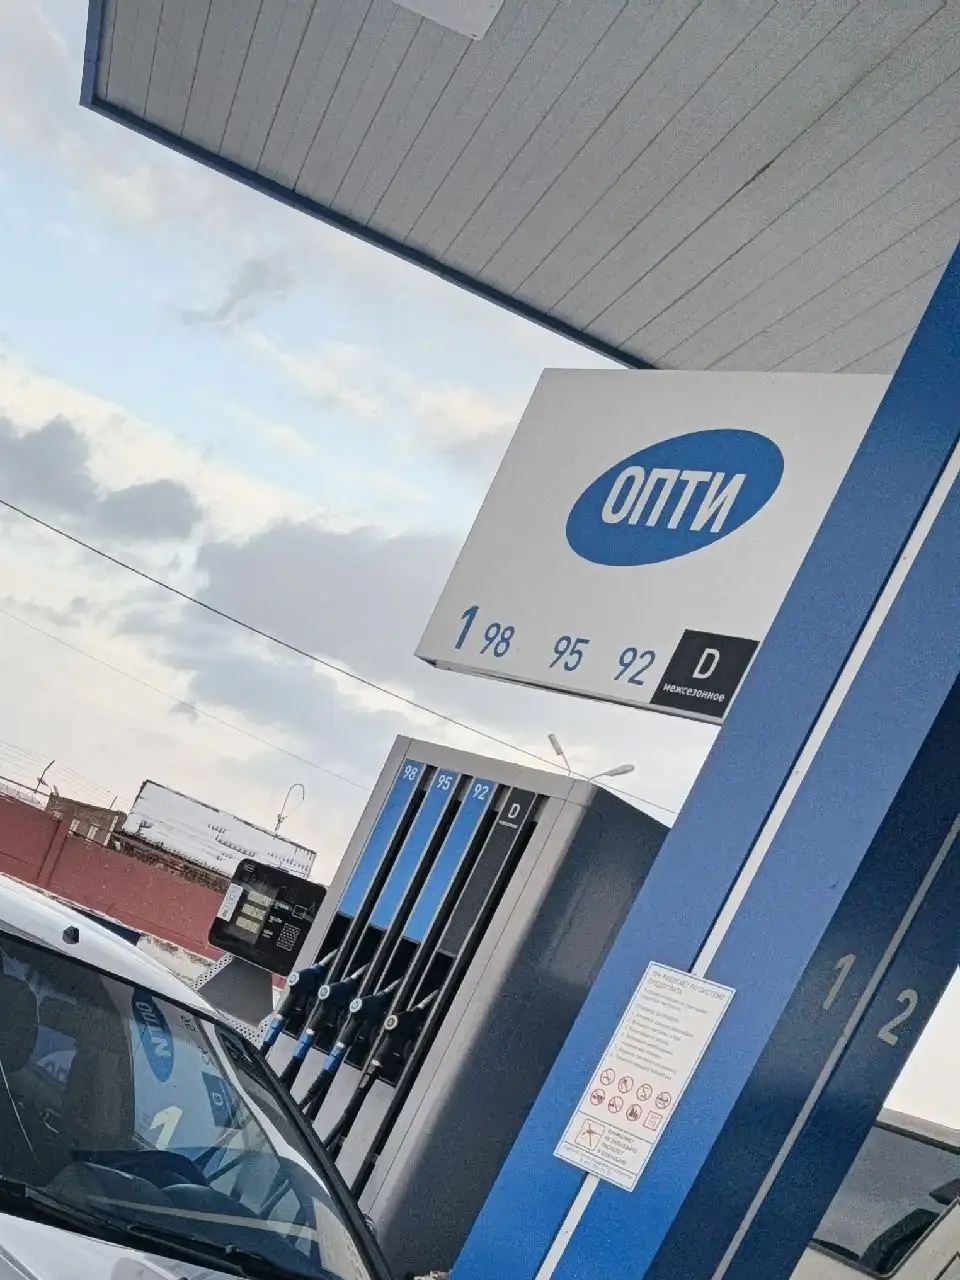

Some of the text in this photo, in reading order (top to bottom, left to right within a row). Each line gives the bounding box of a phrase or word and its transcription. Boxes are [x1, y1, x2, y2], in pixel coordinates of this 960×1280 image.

[601, 465, 747, 533] ОПТИ
[454, 604, 656, 686] 1 98 95 92
[692, 647, 720, 679] D
[663, 683, 725, 702] межсезонное
[402, 765, 489, 800] 98 95 92
[507, 803, 521, 819] D
[822, 953, 856, 1010] 1
[877, 988, 918, 1046] 2
